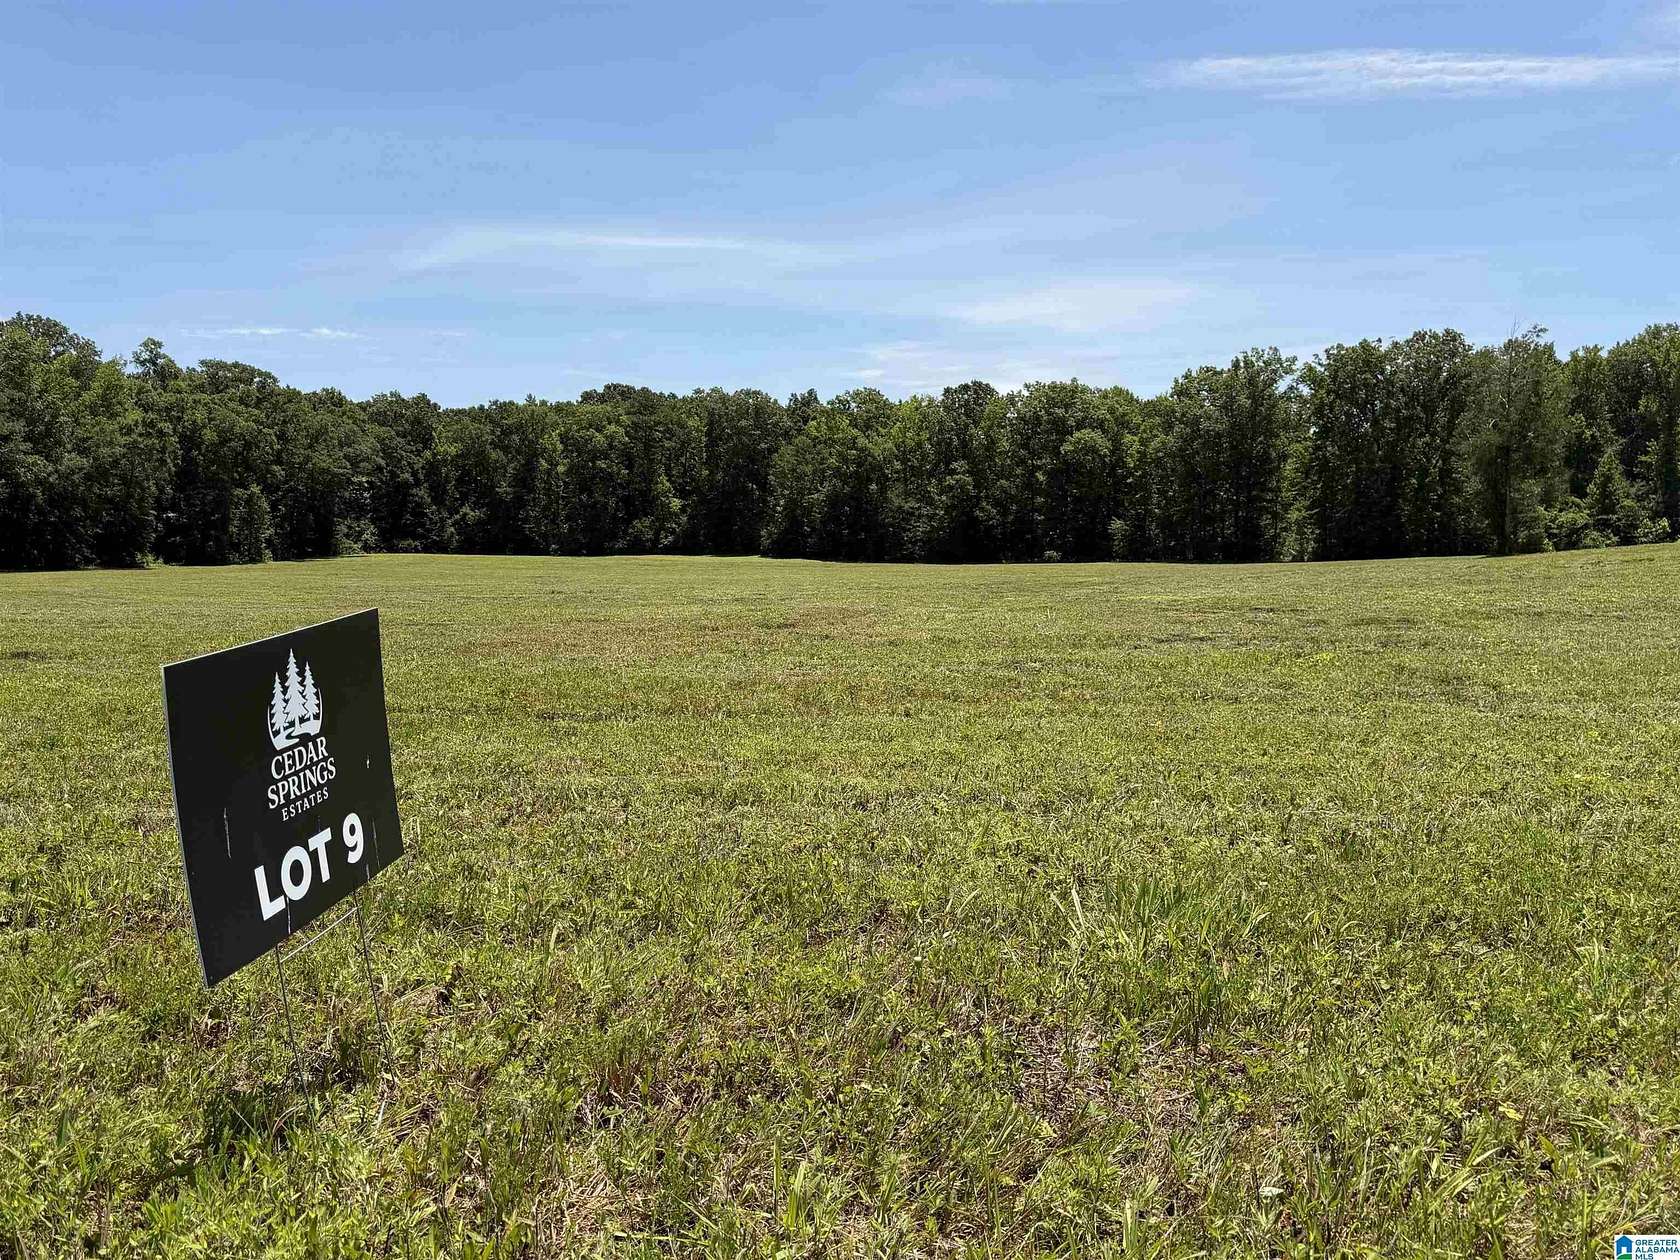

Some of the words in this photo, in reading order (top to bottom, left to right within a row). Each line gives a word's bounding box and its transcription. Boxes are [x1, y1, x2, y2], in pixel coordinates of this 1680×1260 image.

[271, 736, 329, 779] CEDAR
[267, 757, 336, 809] SPRINGS
[281, 786, 329, 821] ESTATES
[254, 827, 333, 922] LOT
[342, 812, 364, 864] 9
